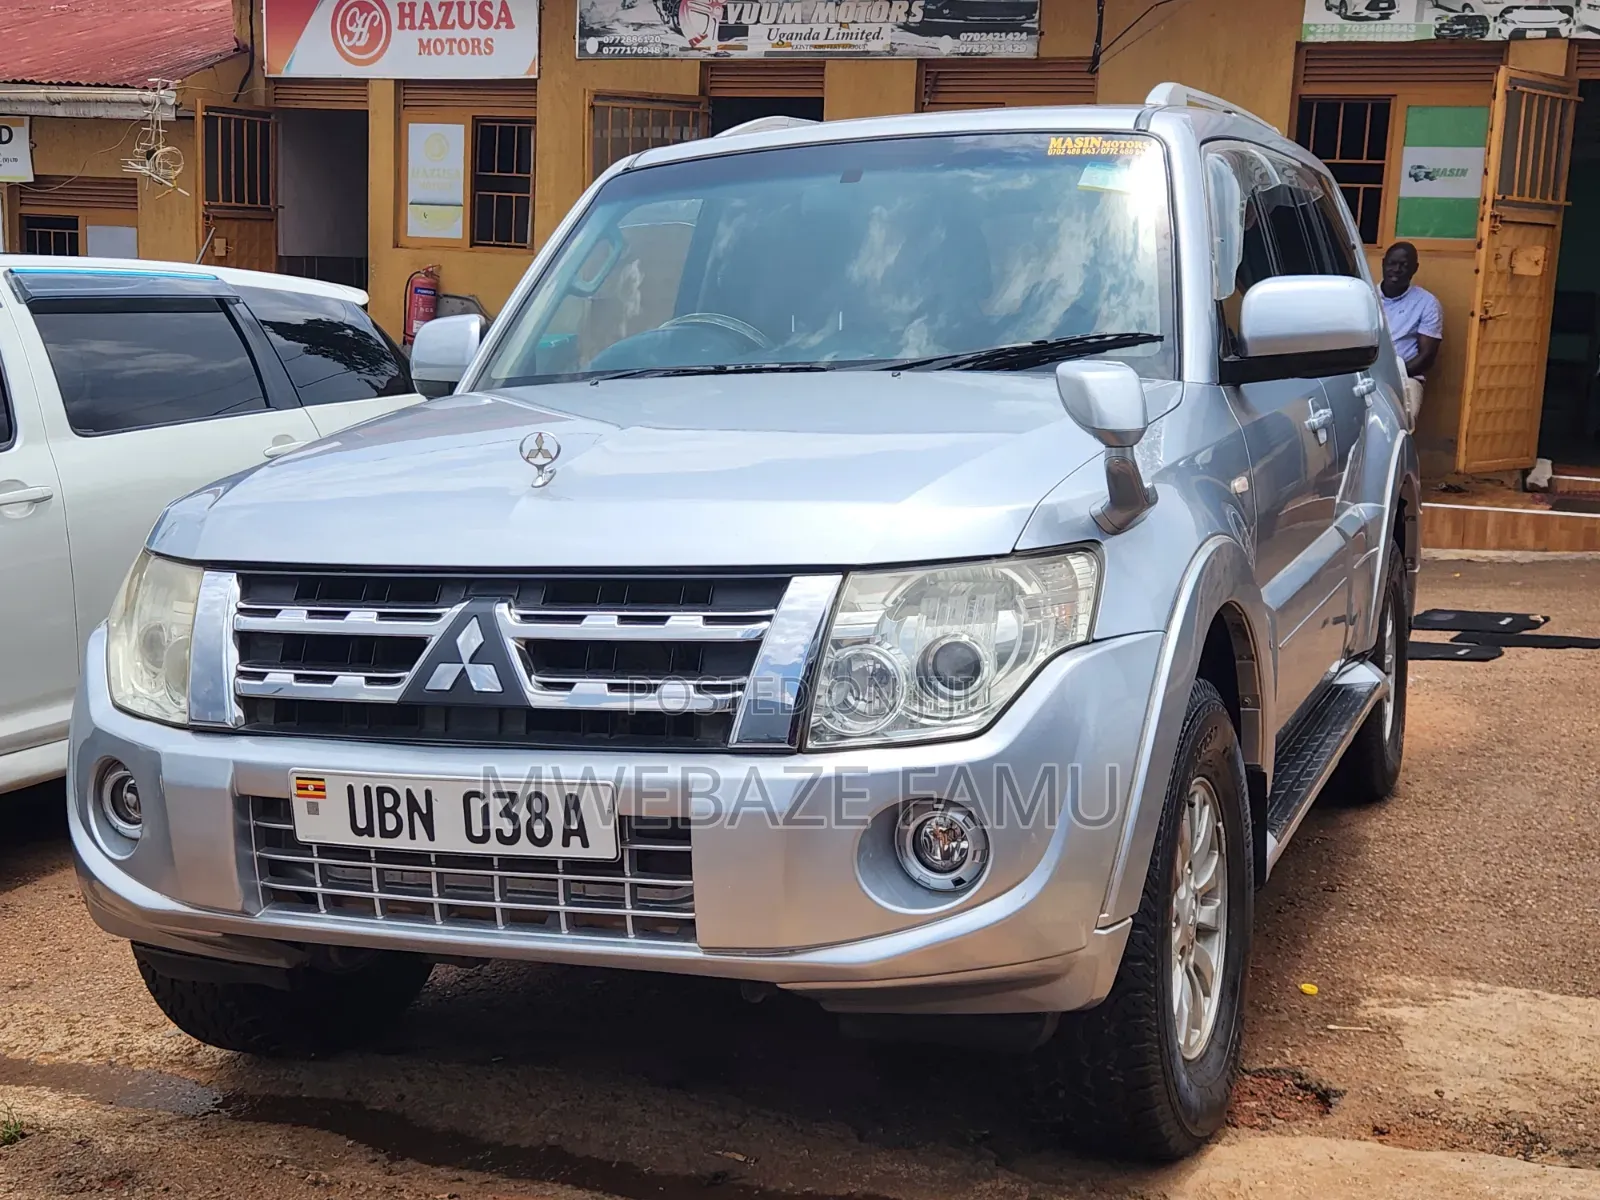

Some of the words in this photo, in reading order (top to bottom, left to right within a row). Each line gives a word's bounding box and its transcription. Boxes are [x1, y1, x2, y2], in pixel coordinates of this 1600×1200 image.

[397, 0, 515, 30] HAZUSA
[811, 0, 926, 22] MOTORS
[602, 35, 661, 44] 0772886120
[766, 27, 820, 46] Uganda
[823, 26, 885, 42] Limited.
[417, 37, 495, 56] MOTORS
[1048, 136, 1102, 149] MASIN
[1431, 167, 1469, 178] MASIN
[347, 783, 436, 842] UBN
[462, 788, 590, 850] 038A
